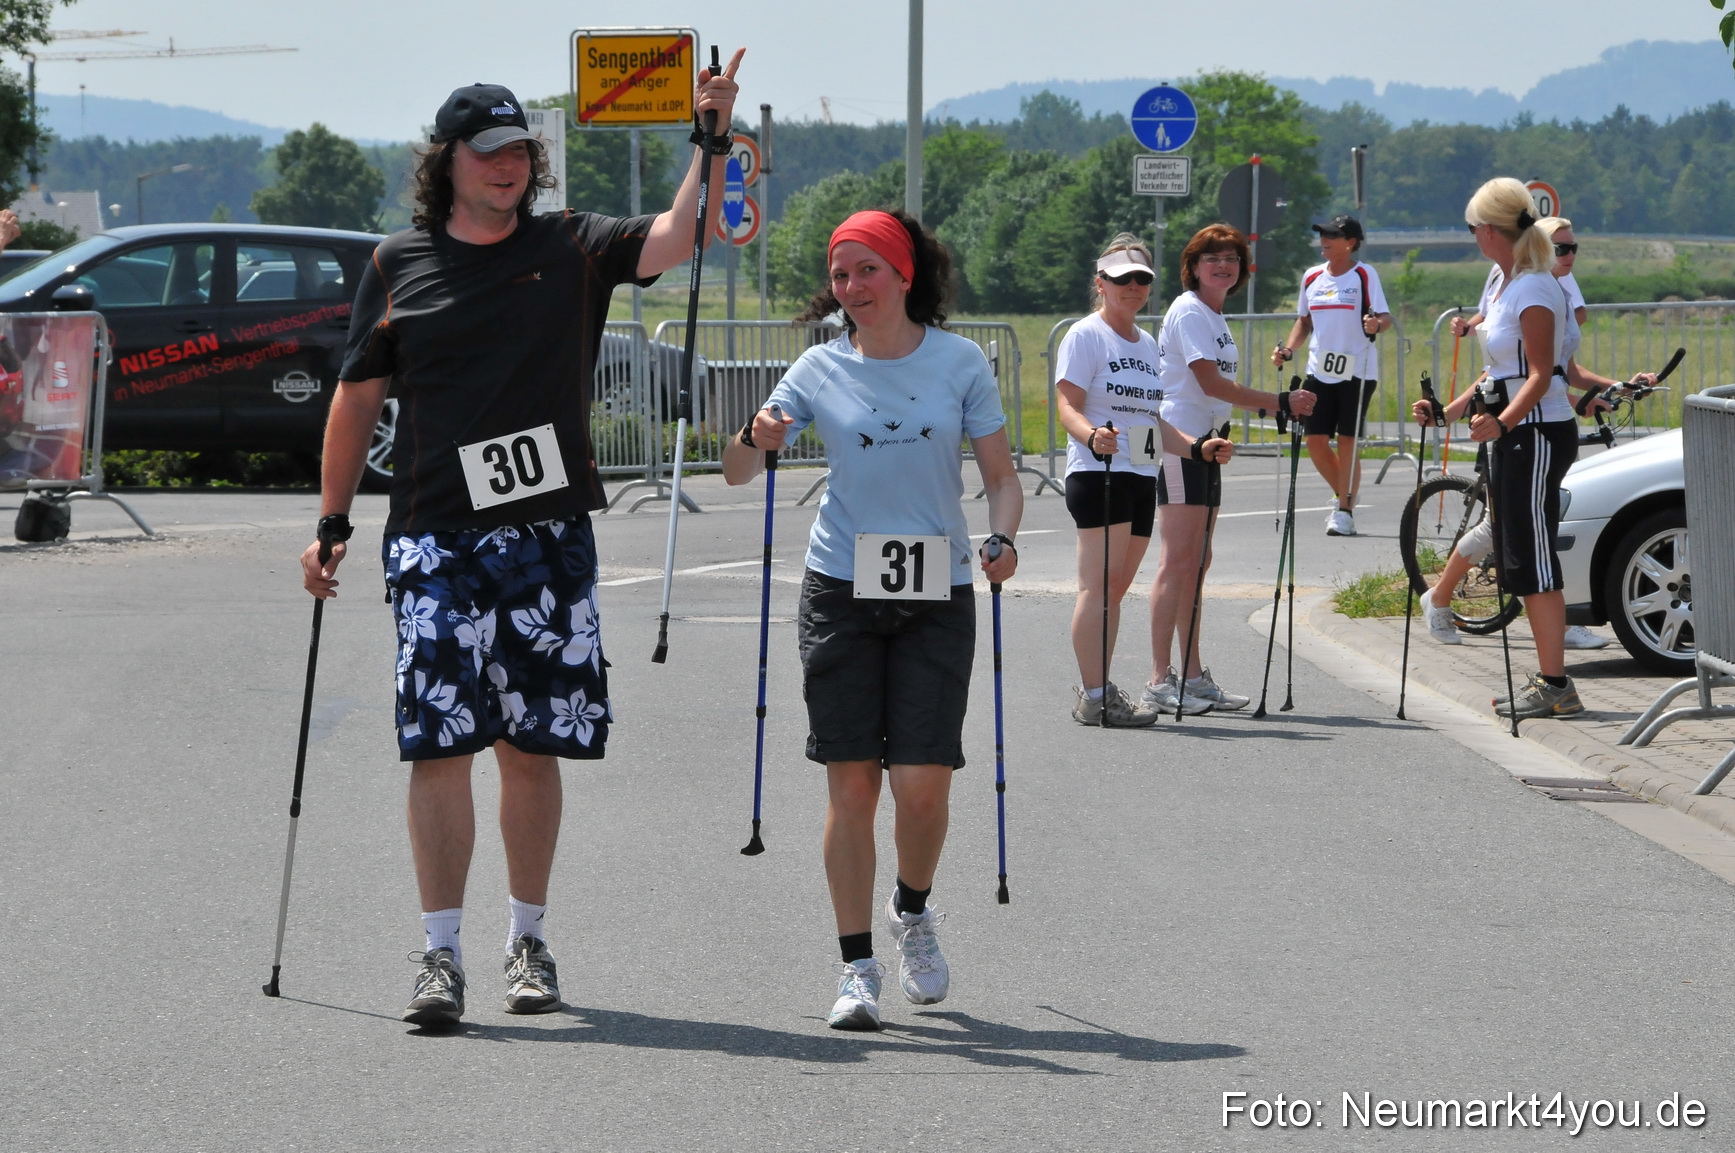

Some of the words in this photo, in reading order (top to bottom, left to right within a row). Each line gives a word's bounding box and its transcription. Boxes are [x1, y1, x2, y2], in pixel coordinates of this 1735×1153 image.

[588, 46, 682, 74] Sengenthal
[600, 77, 621, 88] am
[627, 75, 670, 91] Anger
[611, 101, 653, 112] Neumarkt
[1144, 161, 1180, 170] Landwirt-
[1140, 171, 1184, 180] schaftlicher
[1140, 181, 1168, 190] Verkehr
[1171, 181, 1184, 190] frei
[119, 333, 219, 375] NISSAN
[231, 302, 352, 343] Vertriebspartner
[114, 387, 129, 400] in
[131, 337, 300, 395] Neumarkt-Sengenthal
[1323, 352, 1347, 375] 60
[278, 381, 315, 389] NISSAN
[1106, 381, 1145, 400] POWER
[47, 392, 78, 403] SEAT
[1111, 404, 1137, 414] walking
[876, 438, 899, 449] open
[901, 436, 917, 444] air
[1144, 428, 1155, 460] 4
[482, 435, 545, 495] 30
[880, 540, 925, 593] 31
